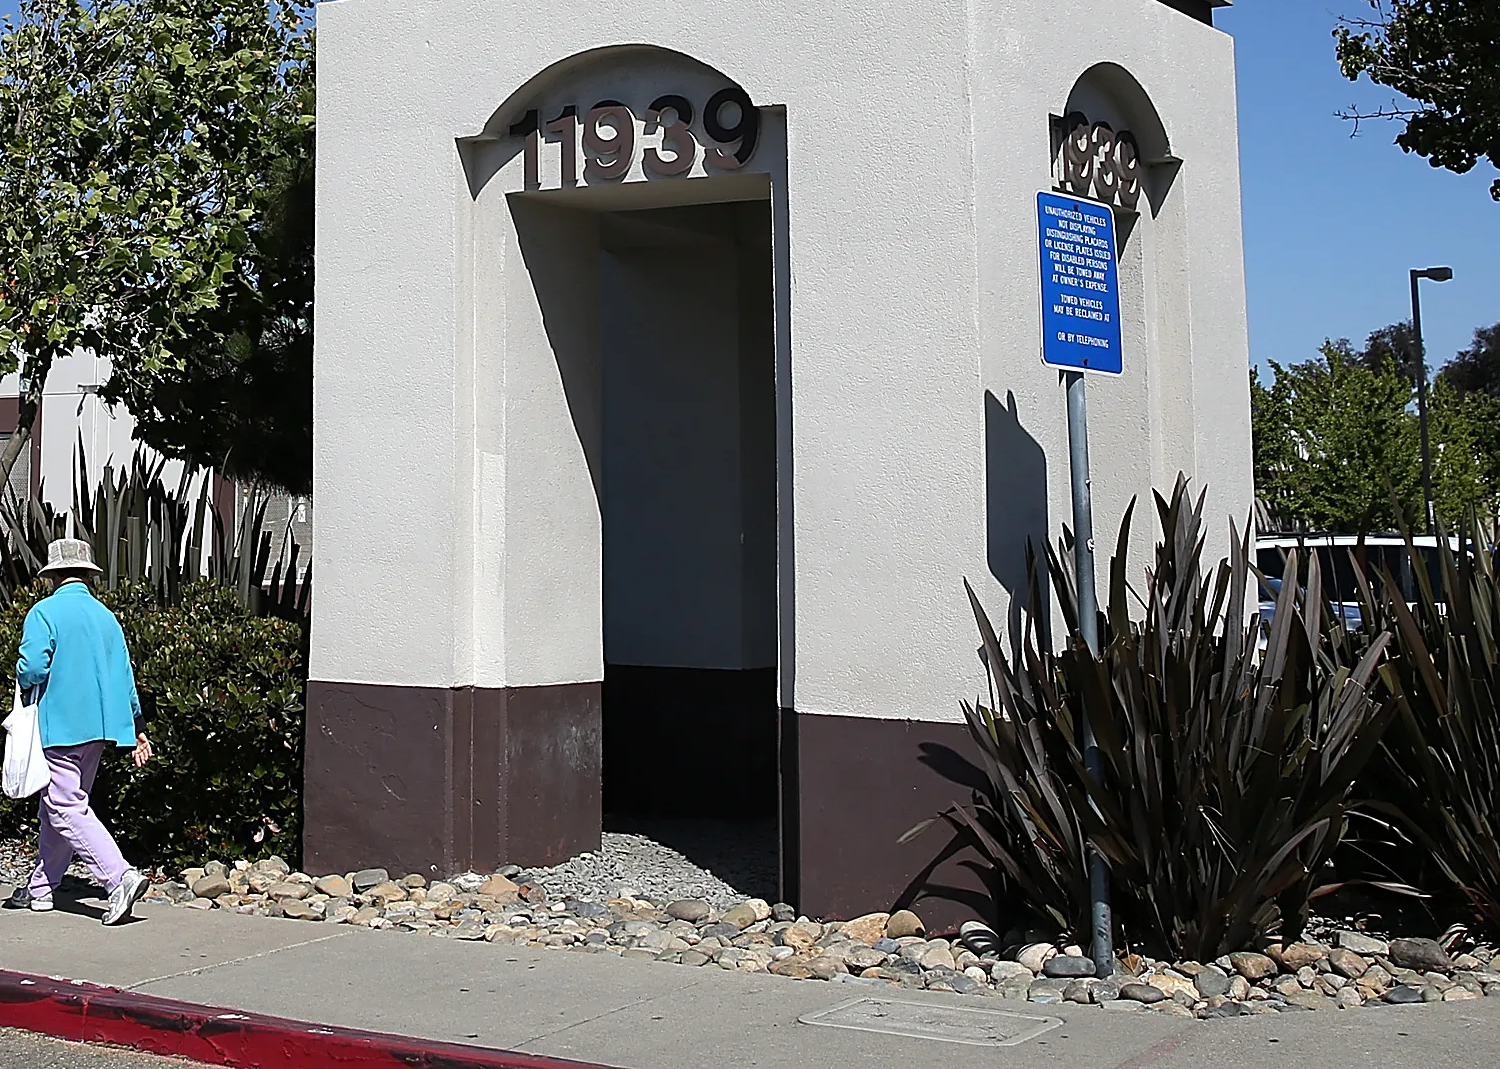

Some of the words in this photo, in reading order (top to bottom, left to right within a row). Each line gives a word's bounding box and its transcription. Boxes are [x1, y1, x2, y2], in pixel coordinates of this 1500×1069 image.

[510, 88, 760, 191] 11939
[1045, 205, 1082, 221] UNAUTHORIZED
[1084, 214, 1106, 227] VEHICLES
[1058, 220, 1068, 229] NOT
[1070, 222, 1096, 235] DISPLAYING
[1046, 228, 1083, 243] DISTINGUISHING
[1085, 236, 1108, 249] PLACARDS
[1045, 239, 1052, 248] OR
[1054, 240, 1074, 252] LICENSE
[1076, 245, 1093, 256] PLATES
[1094, 249, 1111, 260] ISSUED
[1050, 251, 1060, 260] FOR
[1062, 253, 1084, 265] DISABLED
[1086, 258, 1108, 270] PERSONS
[1052, 274, 1059, 283] AT
[1060, 276, 1084, 288] OWNER'S
[1054, 263, 1066, 274] WILL
[1068, 266, 1075, 275] BE
[1076, 267, 1092, 278] TOWED
[1094, 271, 1105, 281] AWAY
[1060, 294, 1078, 305] TOWED
[1079, 297, 1103, 310] VEHICLES
[1053, 304, 1064, 314] MAY
[1066, 306, 1073, 316] BE
[1075, 308, 1103, 321] RECLAIMED
[1104, 314, 1110, 322] AT
[1057, 332, 1066, 341] OR
[1067, 333, 1075, 342] BY
[1076, 335, 1109, 349] TELEPHONING
